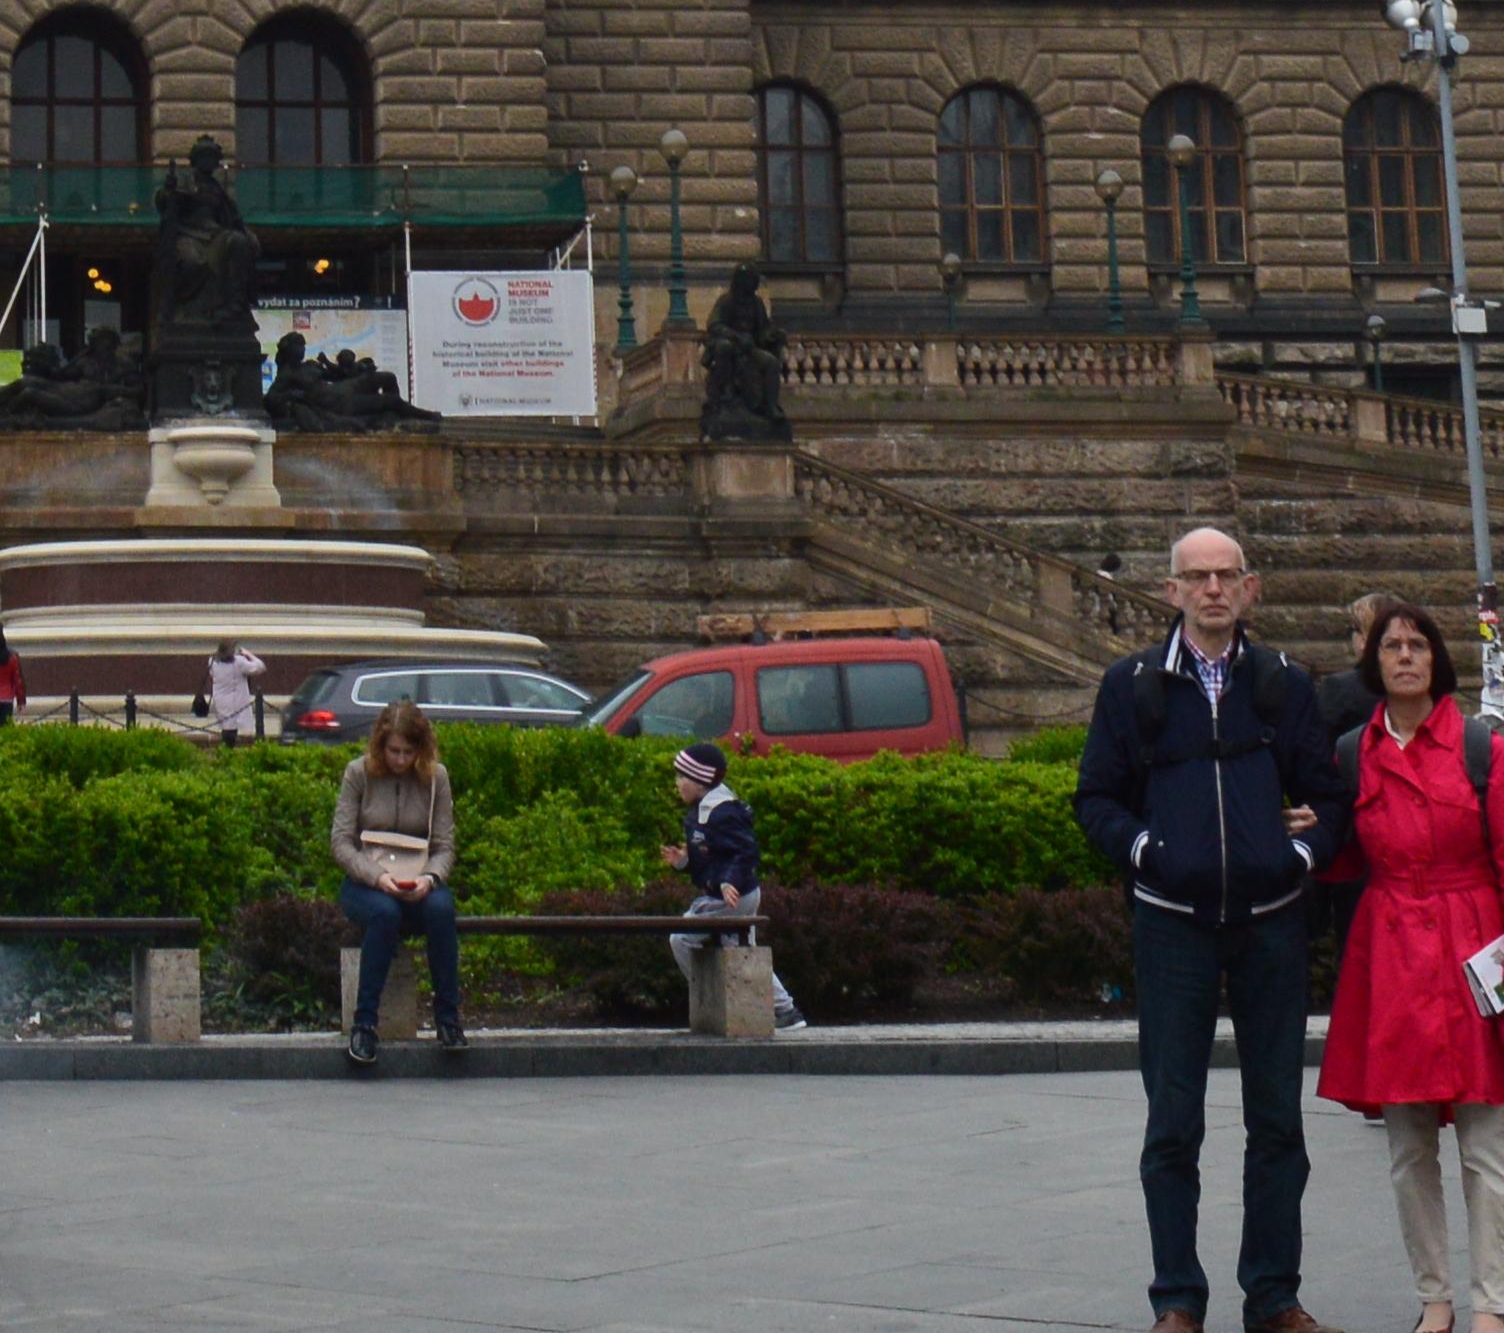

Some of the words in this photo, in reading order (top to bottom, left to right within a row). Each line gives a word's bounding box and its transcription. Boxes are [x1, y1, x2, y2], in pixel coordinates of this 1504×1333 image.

[507, 280, 554, 289] NATIONAL
[507, 289, 550, 297] MUSEUM
[288, 298, 301, 307] za
